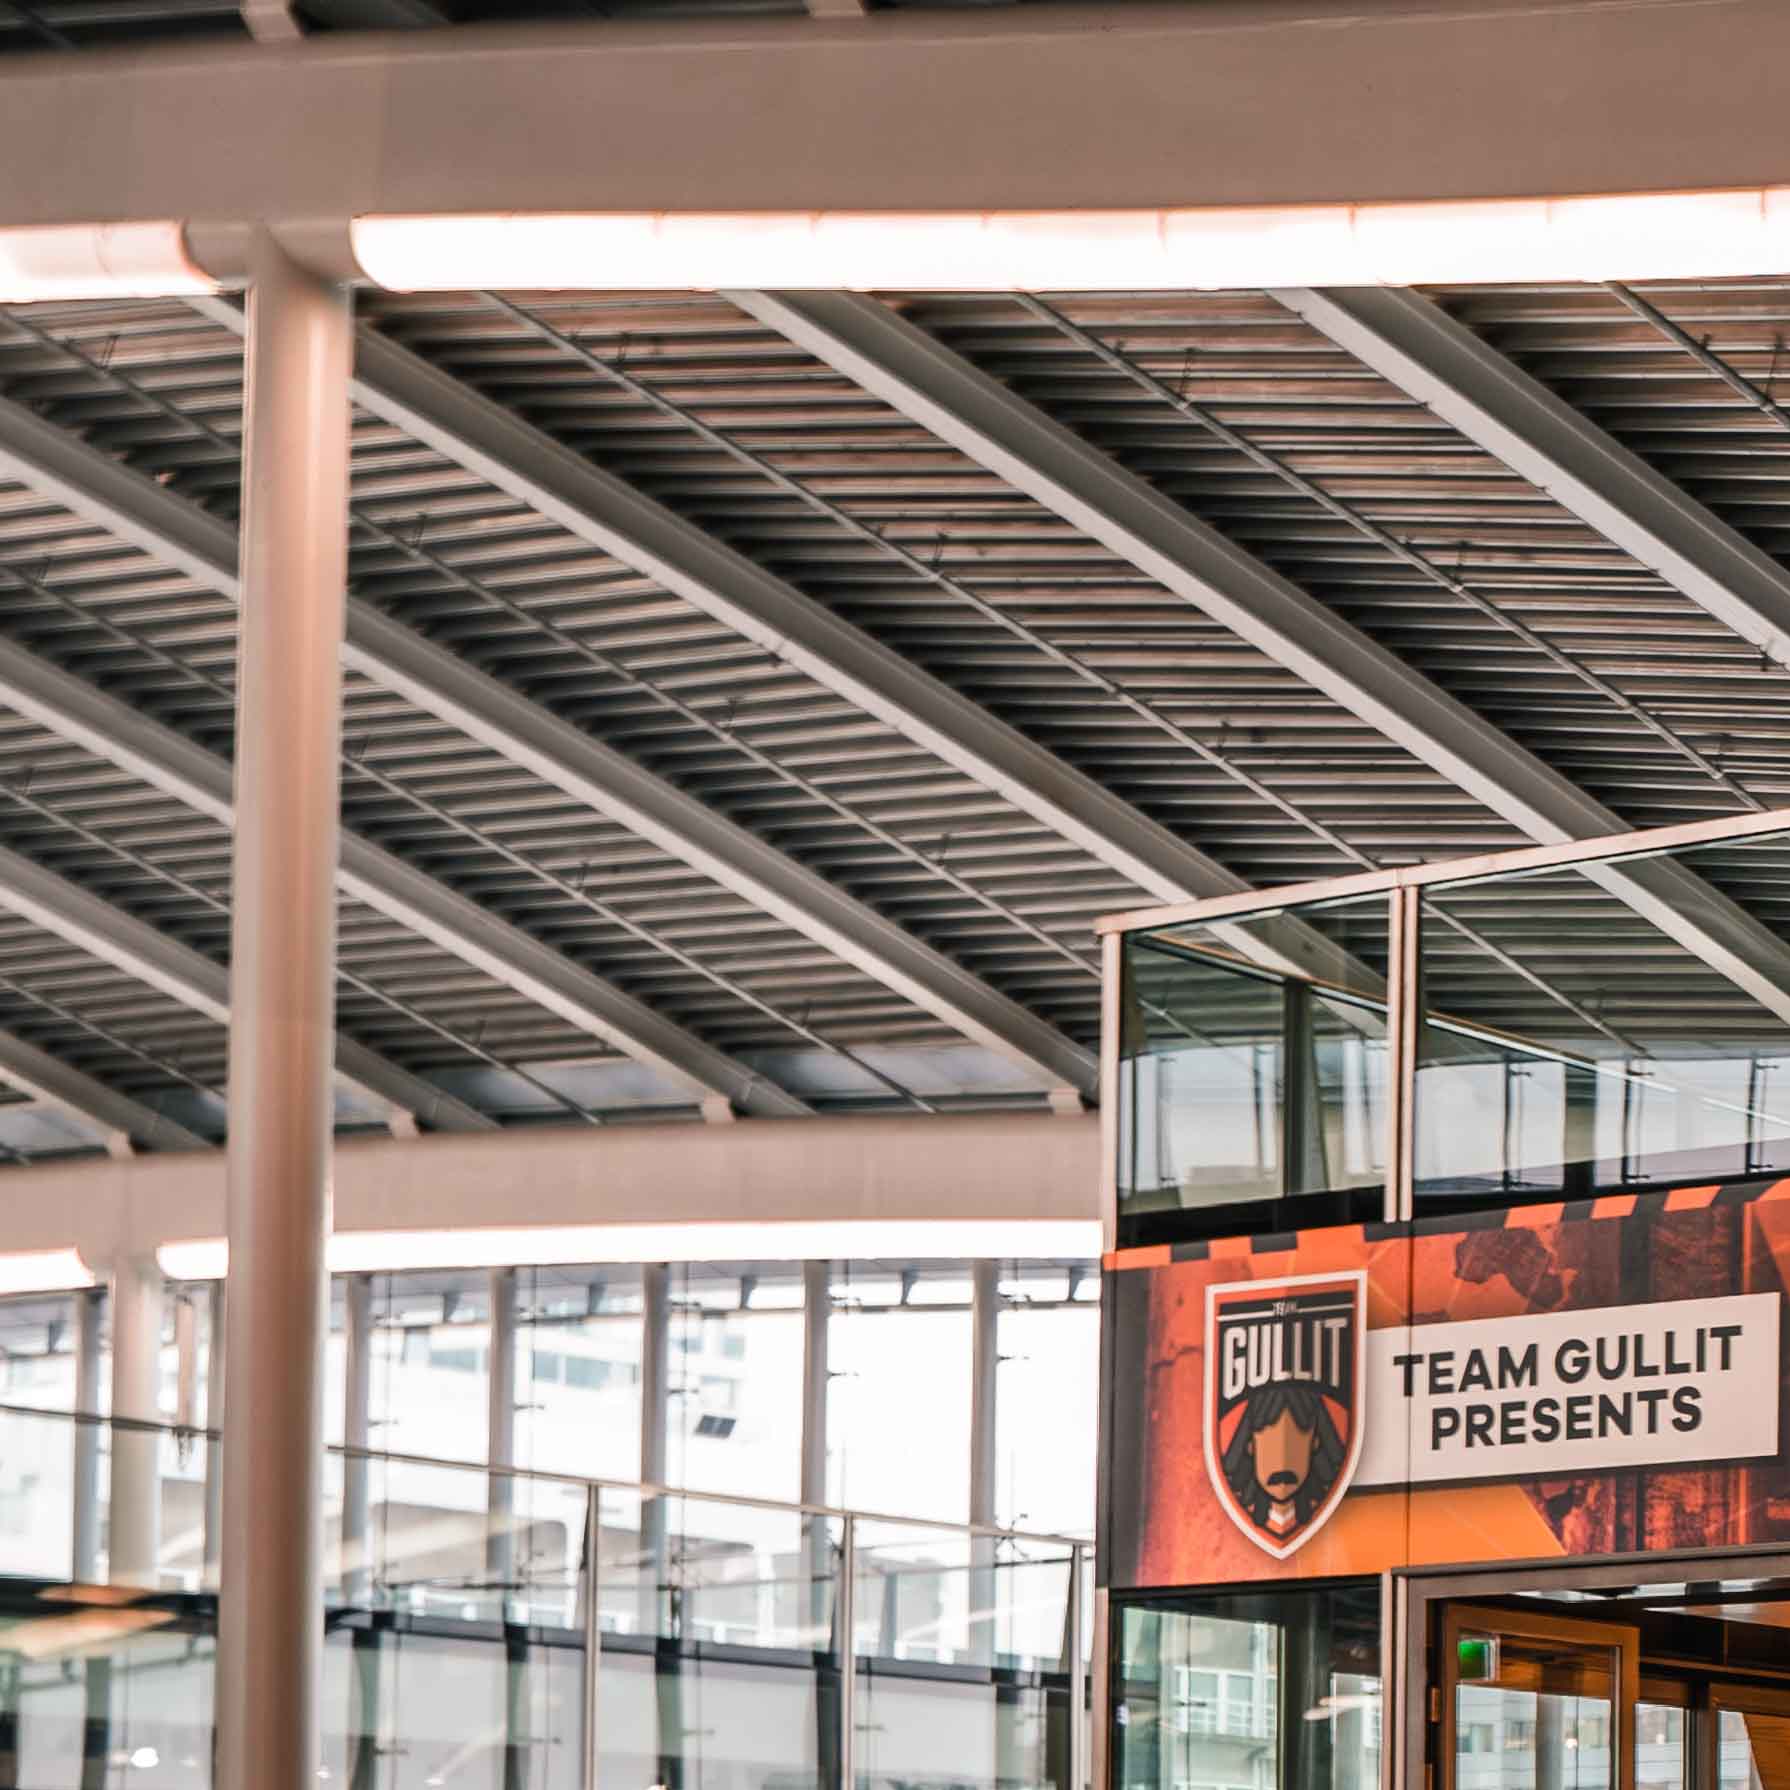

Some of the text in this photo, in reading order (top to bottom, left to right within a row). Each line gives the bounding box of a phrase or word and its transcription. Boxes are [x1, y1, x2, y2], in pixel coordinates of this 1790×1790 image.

[1223, 1317, 1348, 1400] GULLIT
[1393, 1325, 1742, 1397] TEAM GULLIT
[1432, 1387, 1702, 1450] PRESENTS
